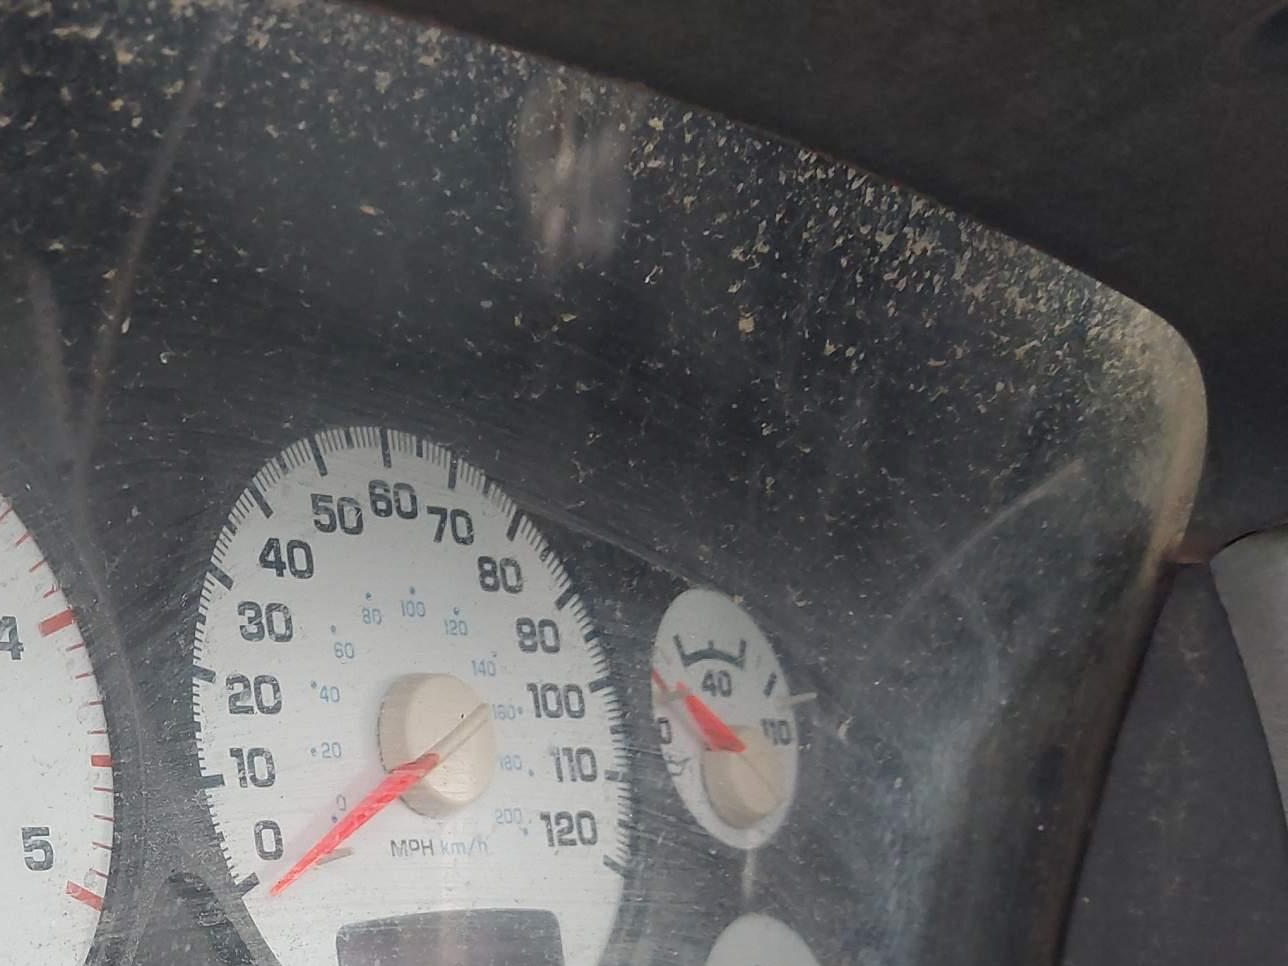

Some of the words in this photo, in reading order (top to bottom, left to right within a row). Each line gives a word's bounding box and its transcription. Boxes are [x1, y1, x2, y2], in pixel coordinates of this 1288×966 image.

[311, 493, 363, 534] 50
[368, 479, 418, 519] 60
[426, 506, 474, 546] 70
[259, 538, 314, 579] 40
[477, 556, 523, 594] 80
[237, 602, 293, 642] 30
[400, 600, 426, 617] 100
[443, 620, 468, 636] 120
[515, 617, 560, 653] 90
[333, 642, 355, 659] 60
[471, 660, 496, 677] 140
[225, 675, 282, 714] 20
[319, 686, 340, 703] 40
[526, 683, 585, 719] 100
[702, 670, 732, 697] 40
[229, 748, 276, 788] 10
[321, 742, 342, 759] 20
[551, 746, 598, 783] 110
[336, 795, 347, 811] 0
[495, 808, 522, 824] 200
[253, 820, 284, 860] 0
[540, 810, 598, 847] 120
[20, 826, 54, 872] 5
[390, 839, 434, 857] MPH
[441, 838, 489, 857] km/h
